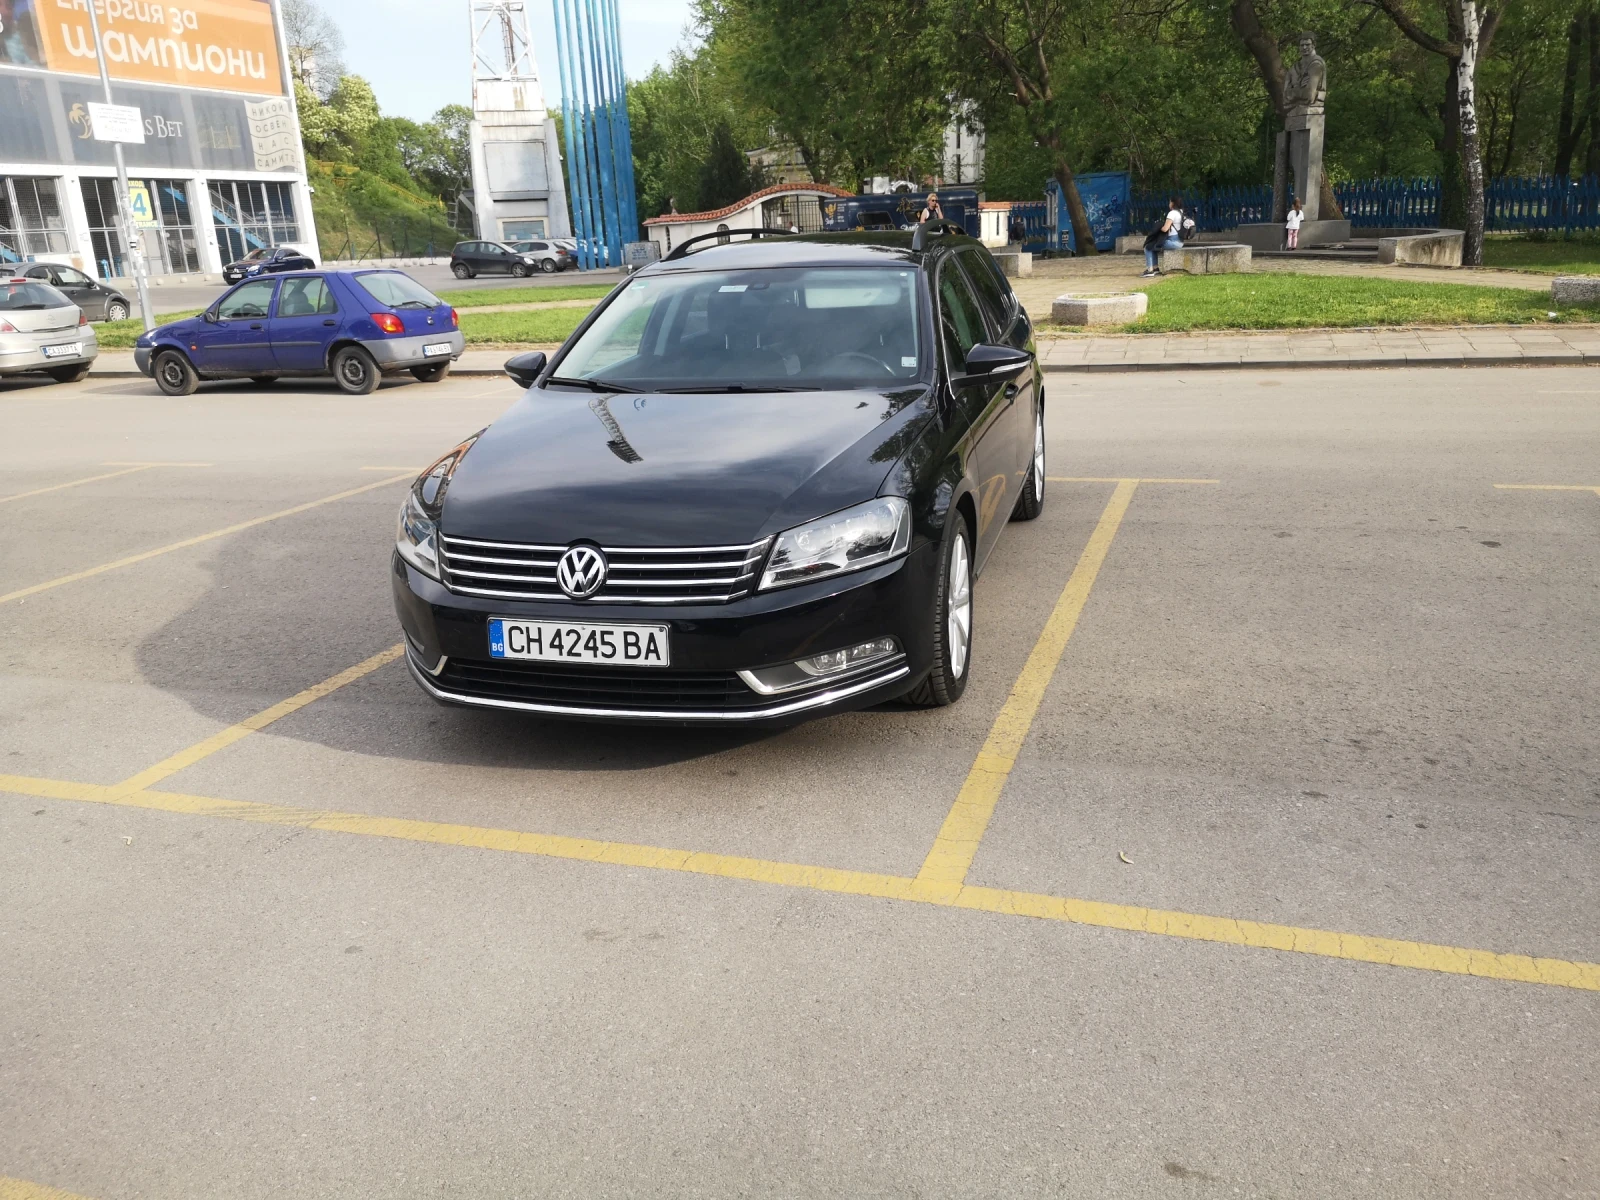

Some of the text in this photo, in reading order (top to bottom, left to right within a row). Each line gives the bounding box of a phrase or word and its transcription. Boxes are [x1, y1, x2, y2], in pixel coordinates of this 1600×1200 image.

[168, 7, 199, 35] за
[61, 23, 266, 79] шампиони
[255, 120, 287, 133] ОСВЕН
[257, 153, 295, 167] САМИТЕ
[133, 193, 147, 216] 4
[557, 546, 606, 597] VW
[491, 642, 504, 652] BG
[508, 625, 661, 661] CH 4245 BA
